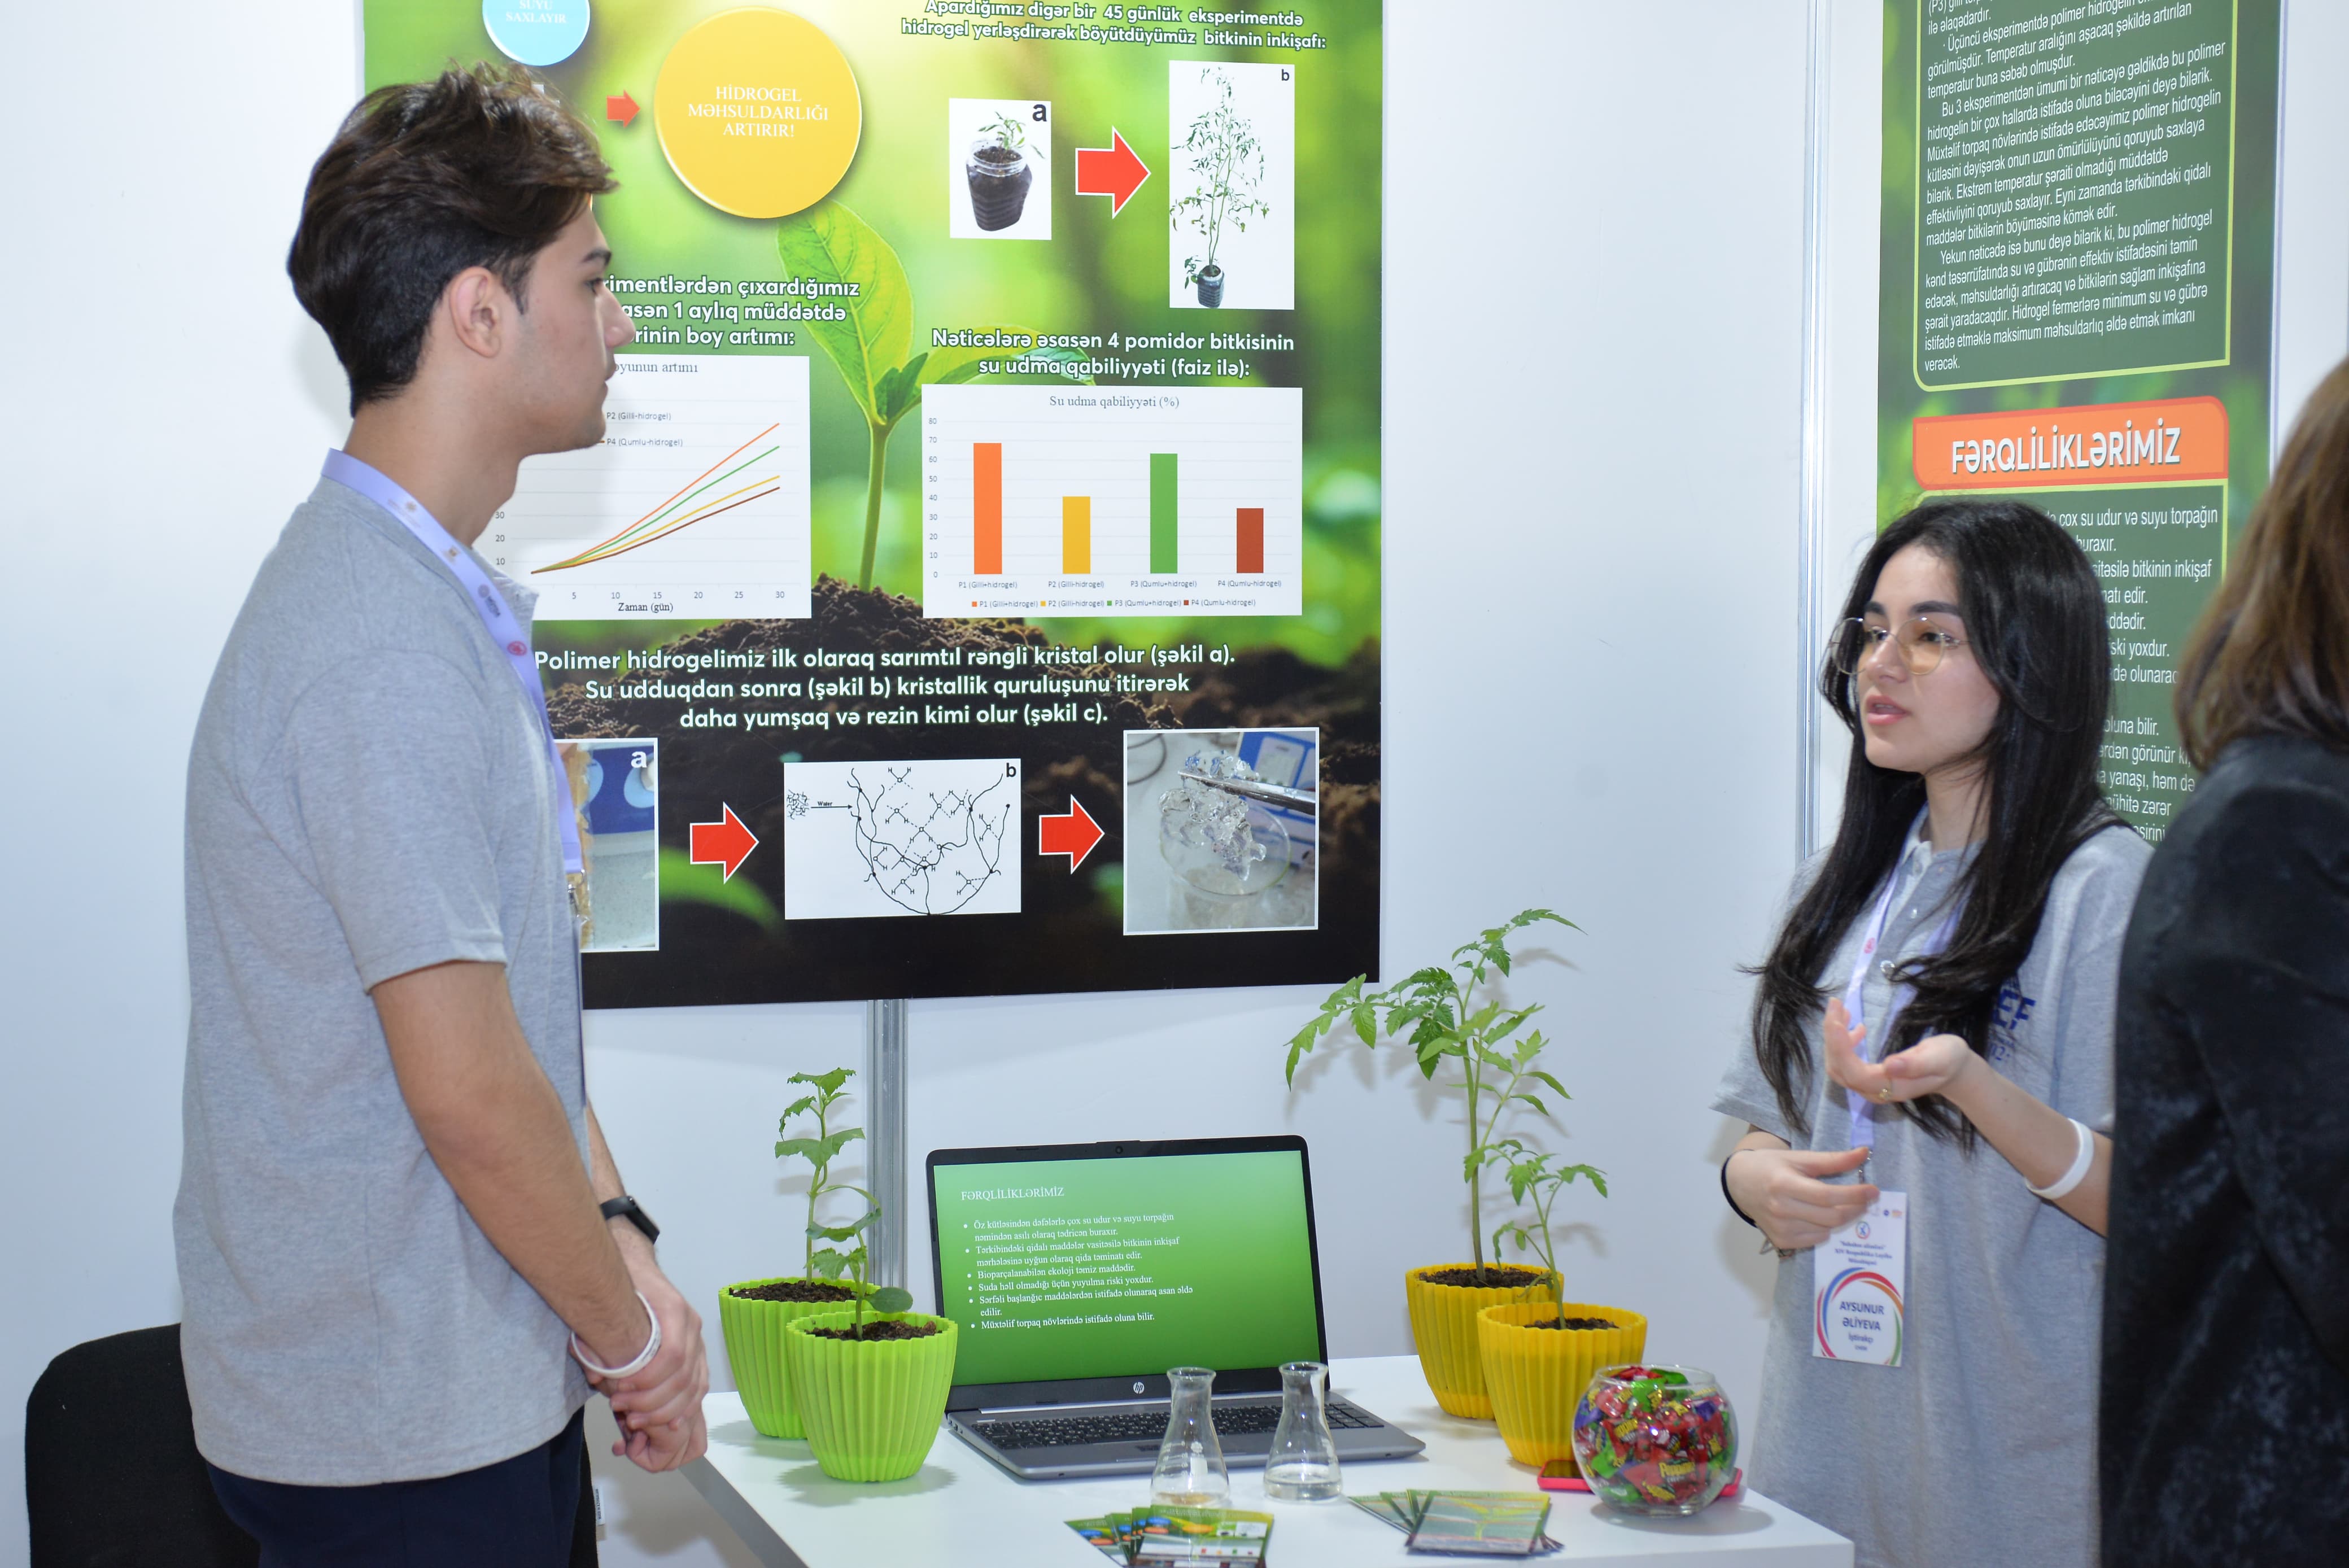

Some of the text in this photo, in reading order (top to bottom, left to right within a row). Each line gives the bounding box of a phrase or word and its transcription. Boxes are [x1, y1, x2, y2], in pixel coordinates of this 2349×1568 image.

[506, 12, 567, 23] SAXLAYIR
[925, 0, 1302, 25] Apardığımız digər bir 45 günlük eksperimentdə
[903, 19, 1325, 50] hidrogel yerləşdirərək böyütdüyümüz bitkinin inkişafı:
[1281, 70, 1290, 81] b
[717, 85, 801, 102] HİDROGEL
[689, 104, 828, 120] MƏHSULDARLIĞI
[1032, 103, 1047, 122] a
[723, 123, 794, 137] ARTIRIR!
[1941, 209, 2212, 264] Yekun nəticədə isə bunu deyə bilərik ki, bu polimer hidrogel
[604, 276, 858, 299] rimentlərdən çıxardığımız
[1926, 259, 2205, 308] edəcək, məhsuldarlığı artıracaq və bitkilərin sağlam inkişafına
[622, 302, 845, 322] asən 1 aylıq müddətdə
[636, 326, 793, 347] rinin boy artımı:
[934, 330, 1293, 351] Nəticələrə əsasən 4 pomidor bitkisinin
[615, 363, 697, 374] oyunun artımı
[980, 356, 1248, 378] su udma qabiliyyəti (faiz ilə):
[1925, 355, 1959, 371] verəcək.
[1050, 396, 1179, 409] Su udma qabiliyyəti (%)
[1953, 418, 2180, 472] FƏRQLİLİKLƏRİMİZ
[2081, 513, 2093, 526] su
[2097, 508, 2122, 526] udur
[2125, 512, 2137, 525] və
[2141, 512, 2167, 529] suyu
[2171, 506, 2217, 528] torpağın
[2133, 559, 2212, 582] bitkinin inkişaf
[2124, 586, 2148, 604] edir.
[618, 602, 673, 613] Zaman (gün)
[535, 645, 1234, 672] Polimer hidrogelimiz ilk olaraq sarımtıl rəngli kristal olur (şəkil a).
[2129, 638, 2169, 660] yoxdur.
[586, 674, 1189, 702] Su udduqdan sonra (şəkil b) kristallik quruluşunu itirərək
[680, 704, 1107, 730] daha yumşaq və rezin kimi olur (şəkil c).
[2137, 717, 2159, 735] bilir.
[631, 751, 647, 768] a
[2132, 744, 2176, 765] görünür
[1006, 763, 1016, 778] b
[2110, 771, 2194, 792] yanaşı, həm də
[2142, 800, 2172, 816] zərər
[1840, 1301, 1884, 1314] AYSUNUR
[1842, 1316, 1881, 1330] ƏLİYEVA
[1133, 1382, 1145, 1394] hp
